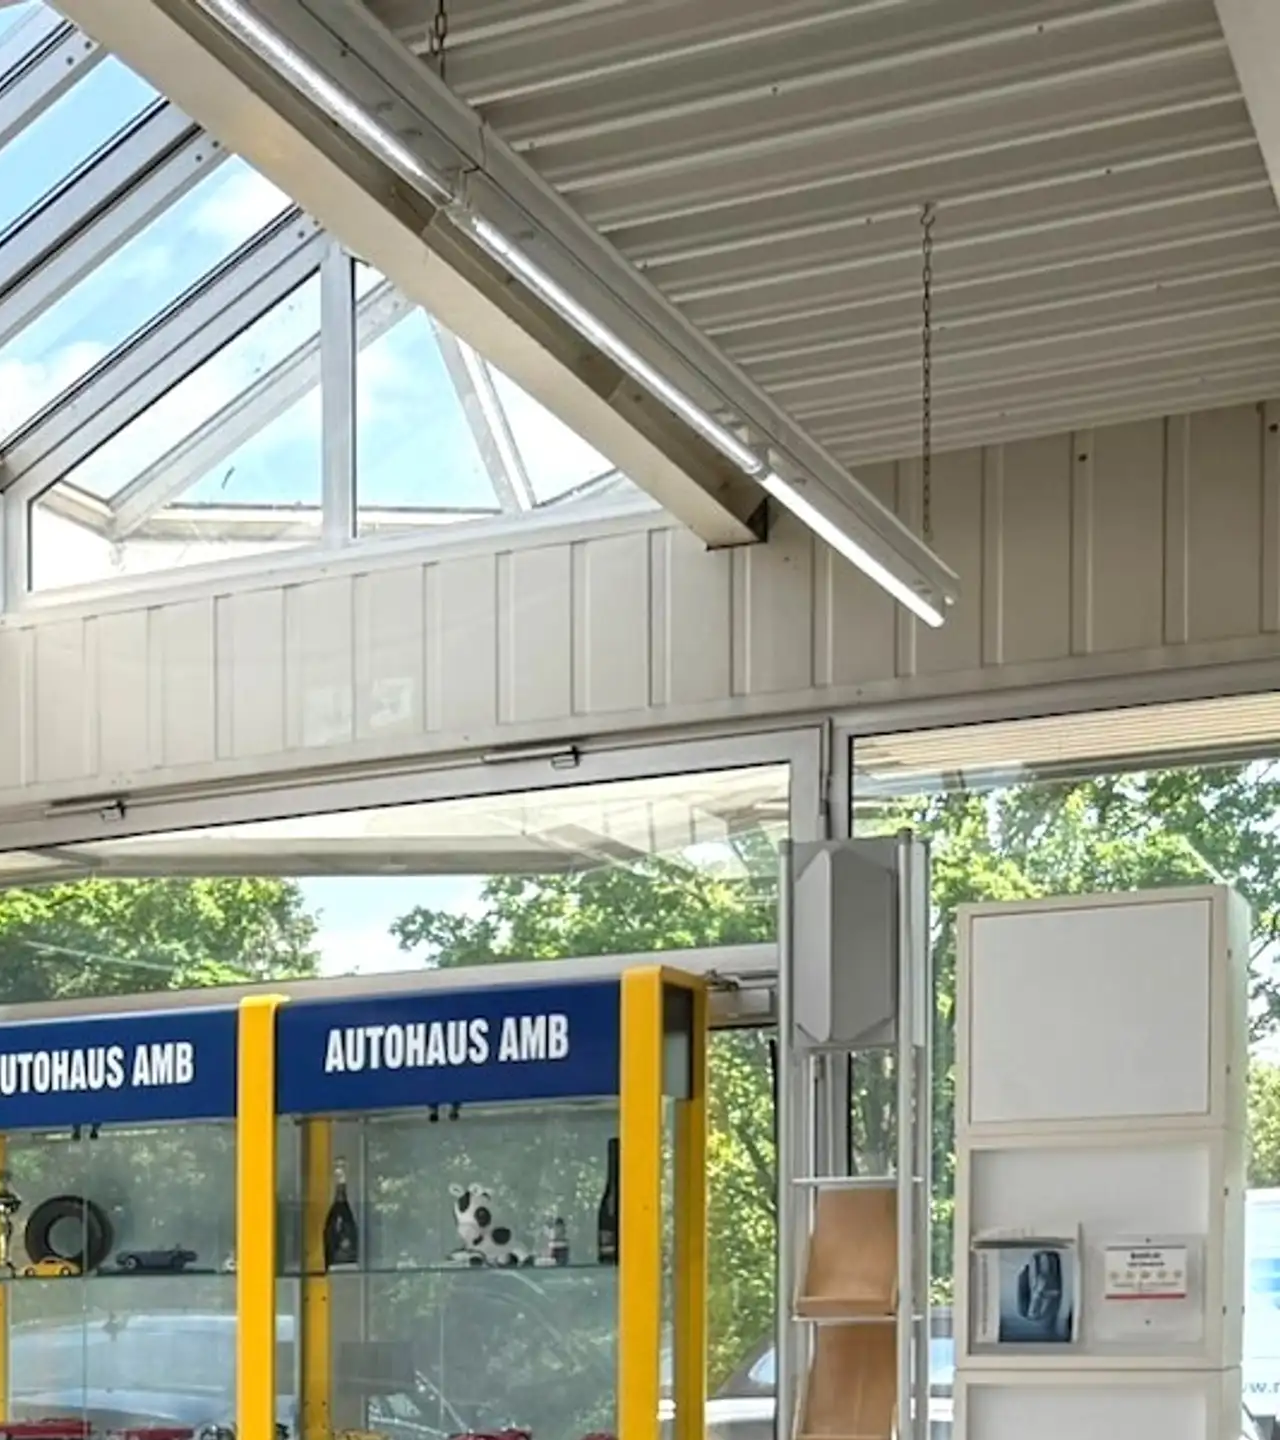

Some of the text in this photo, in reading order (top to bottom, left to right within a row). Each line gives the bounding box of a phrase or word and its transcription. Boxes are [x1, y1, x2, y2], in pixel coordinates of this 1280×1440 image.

[132, 1042, 194, 1087] AMB
[325, 1014, 569, 1072] AUTOHAUS AMB
